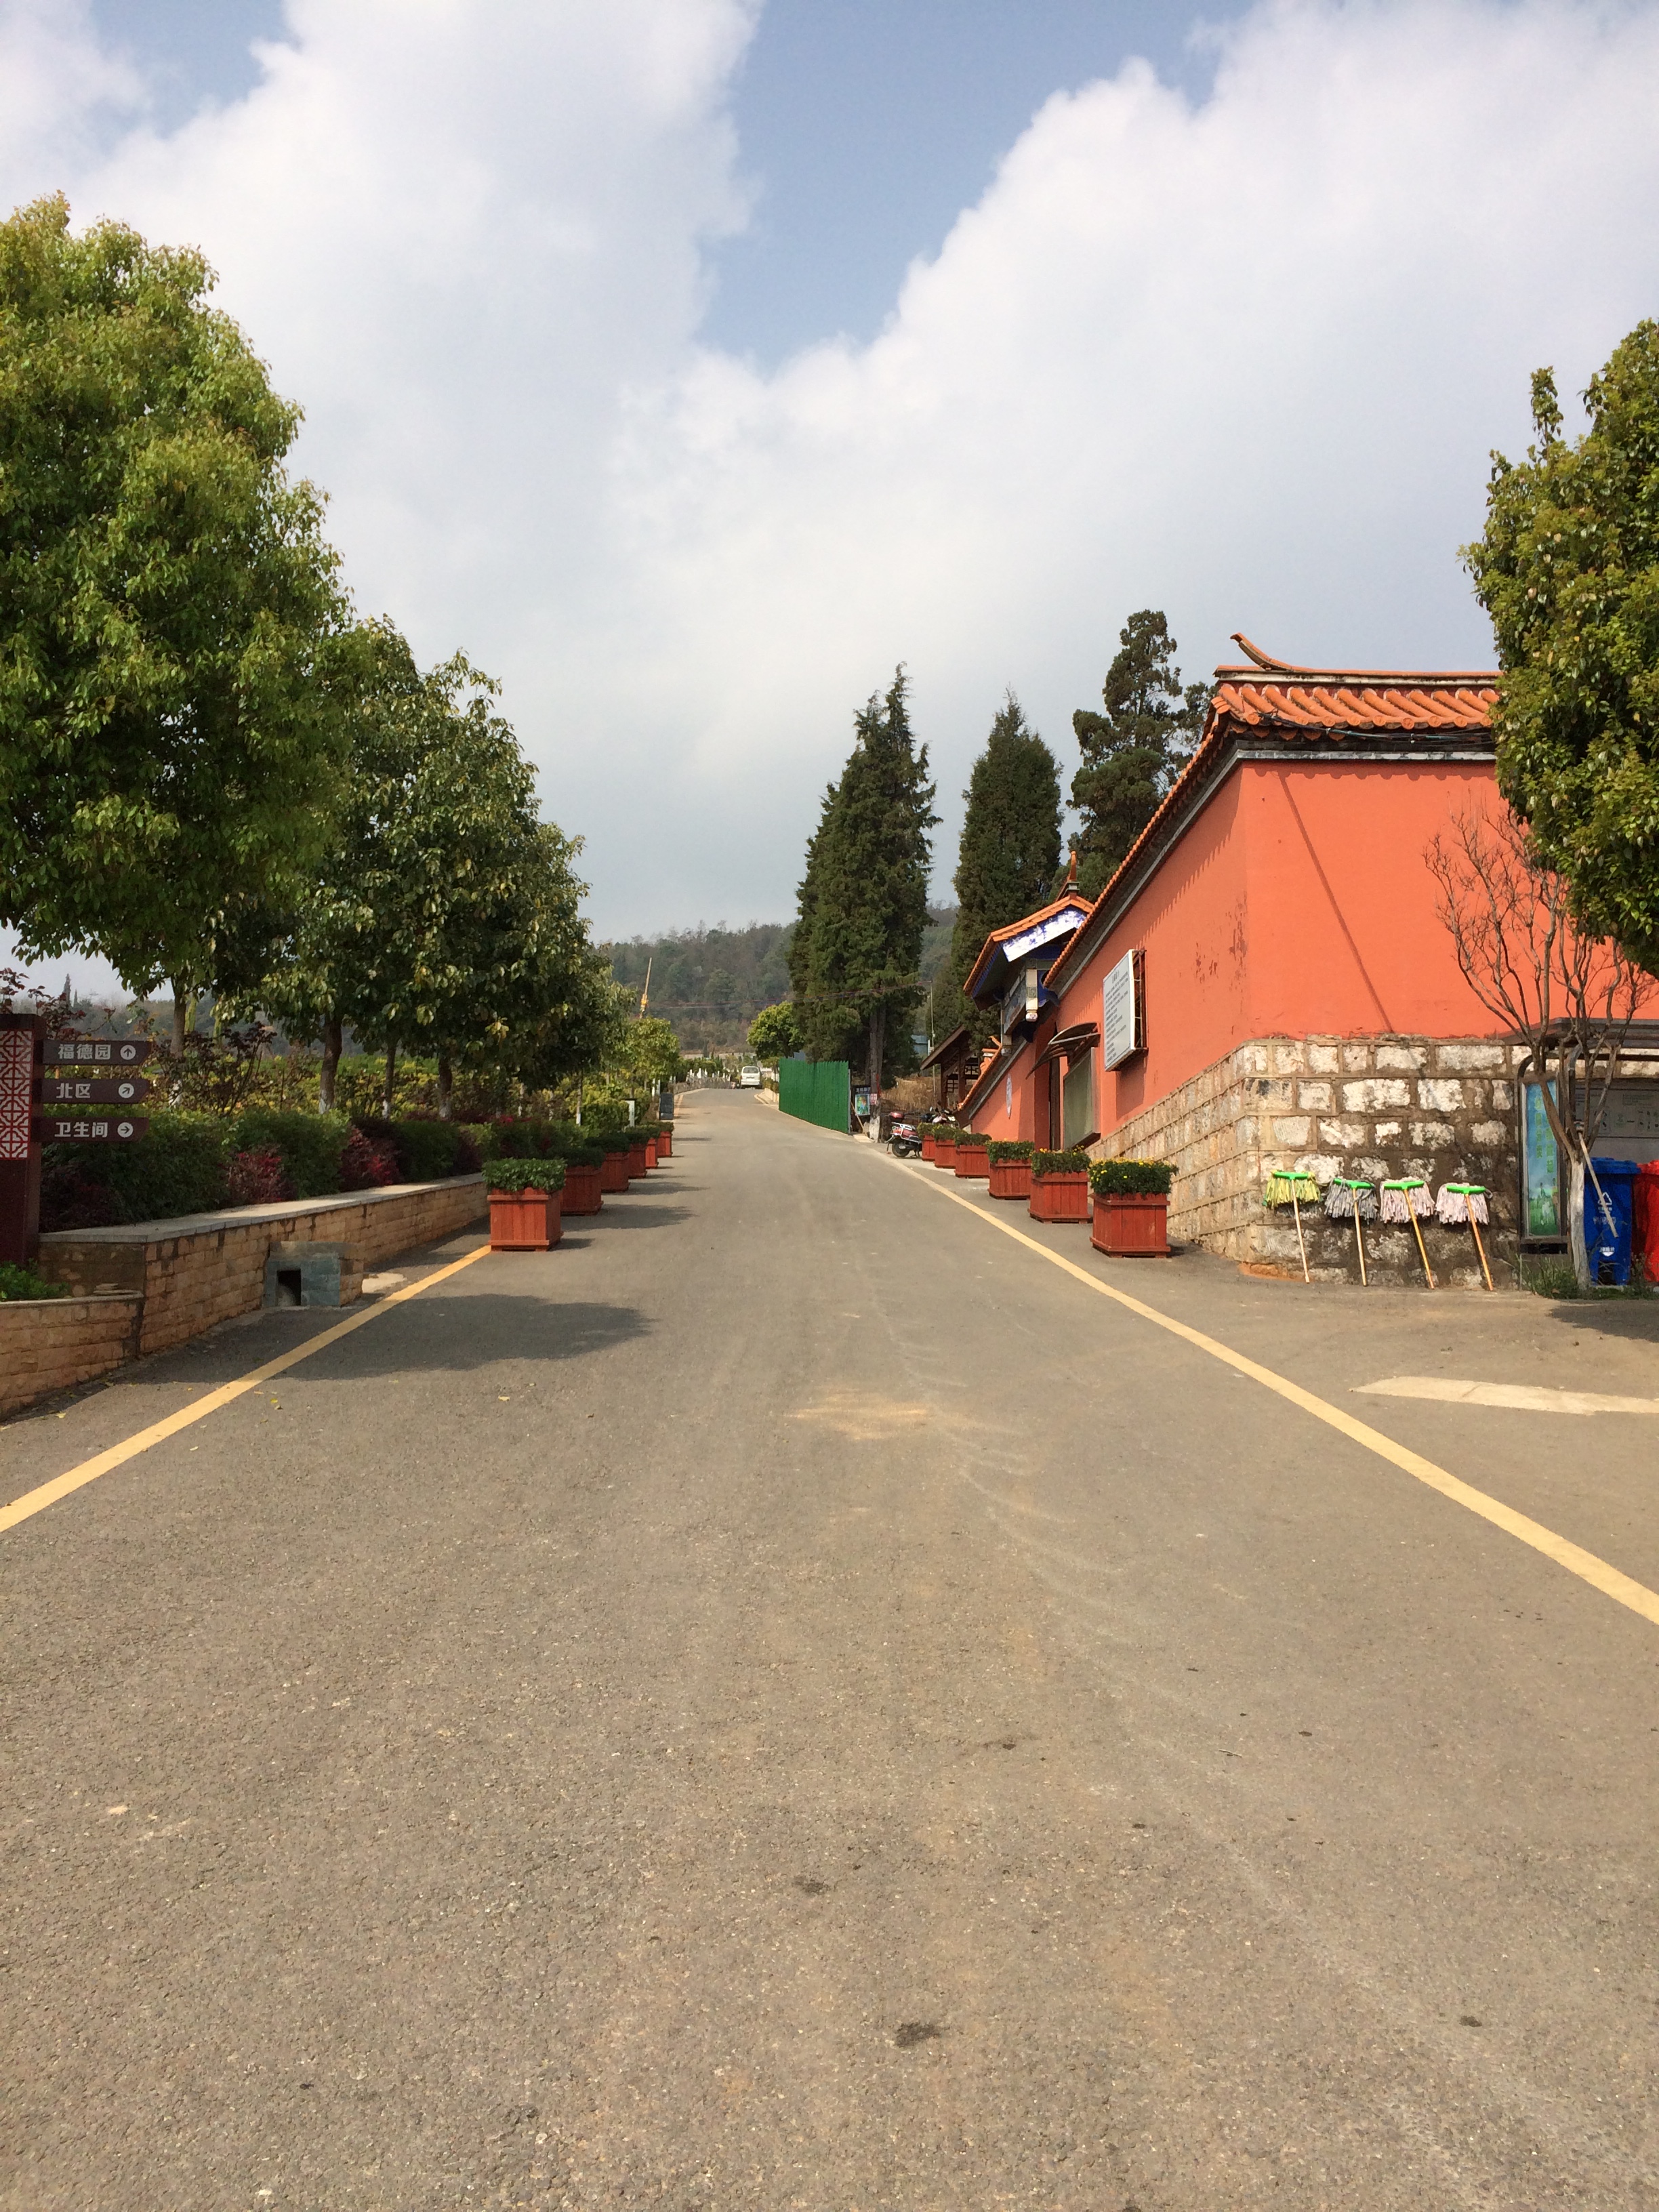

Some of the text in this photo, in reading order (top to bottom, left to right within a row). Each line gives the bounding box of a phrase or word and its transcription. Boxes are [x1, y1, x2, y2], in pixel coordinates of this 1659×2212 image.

[58, 1044, 111, 1060] 福德园
[56, 1083, 91, 1099] 北区
[54, 1122, 108, 1138] 卫生间
